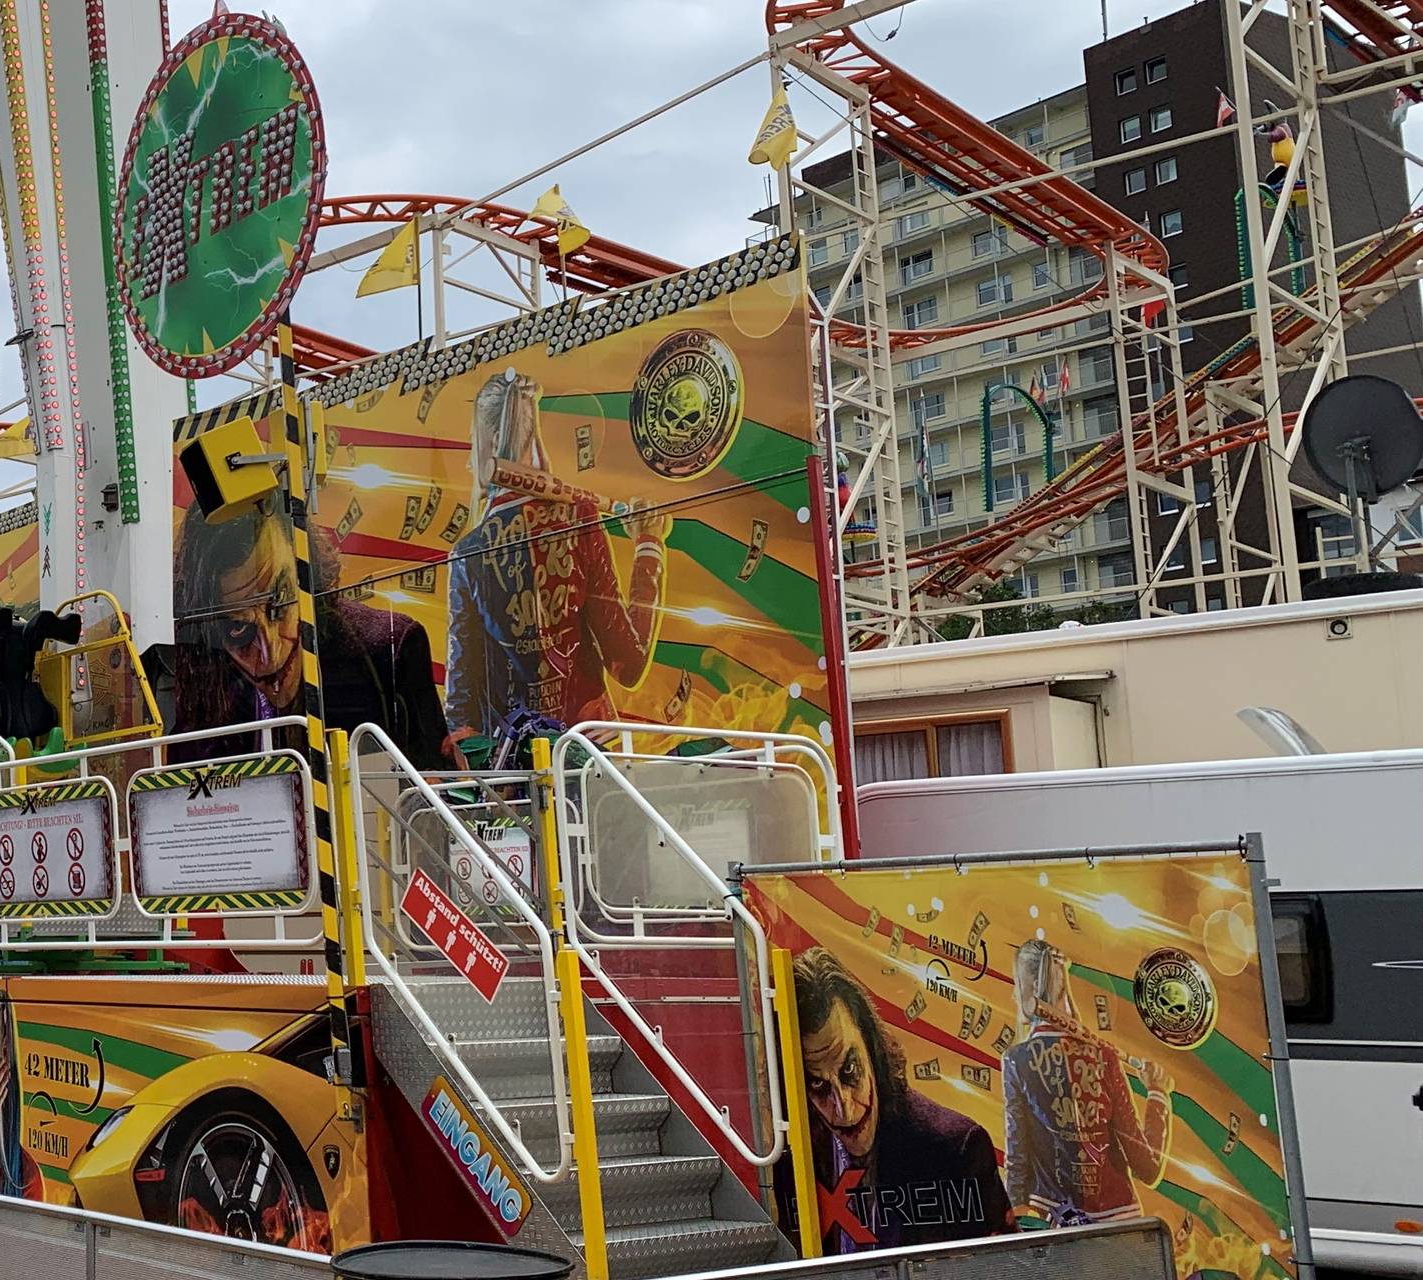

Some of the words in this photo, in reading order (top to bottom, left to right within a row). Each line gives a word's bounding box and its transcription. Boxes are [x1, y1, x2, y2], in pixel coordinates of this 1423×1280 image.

[129, 101, 298, 300] EXTREM
[186, 770, 242, 800] EXTREM
[415, 877, 460, 927] Abstand
[458, 924, 504, 973] schützt!
[25, 1053, 40, 1077] 42
[43, 1056, 90, 1088] METER
[28, 1128, 42, 1150] 120
[44, 1131, 68, 1158] KM/H
[429, 1090, 522, 1222] EINGANG
